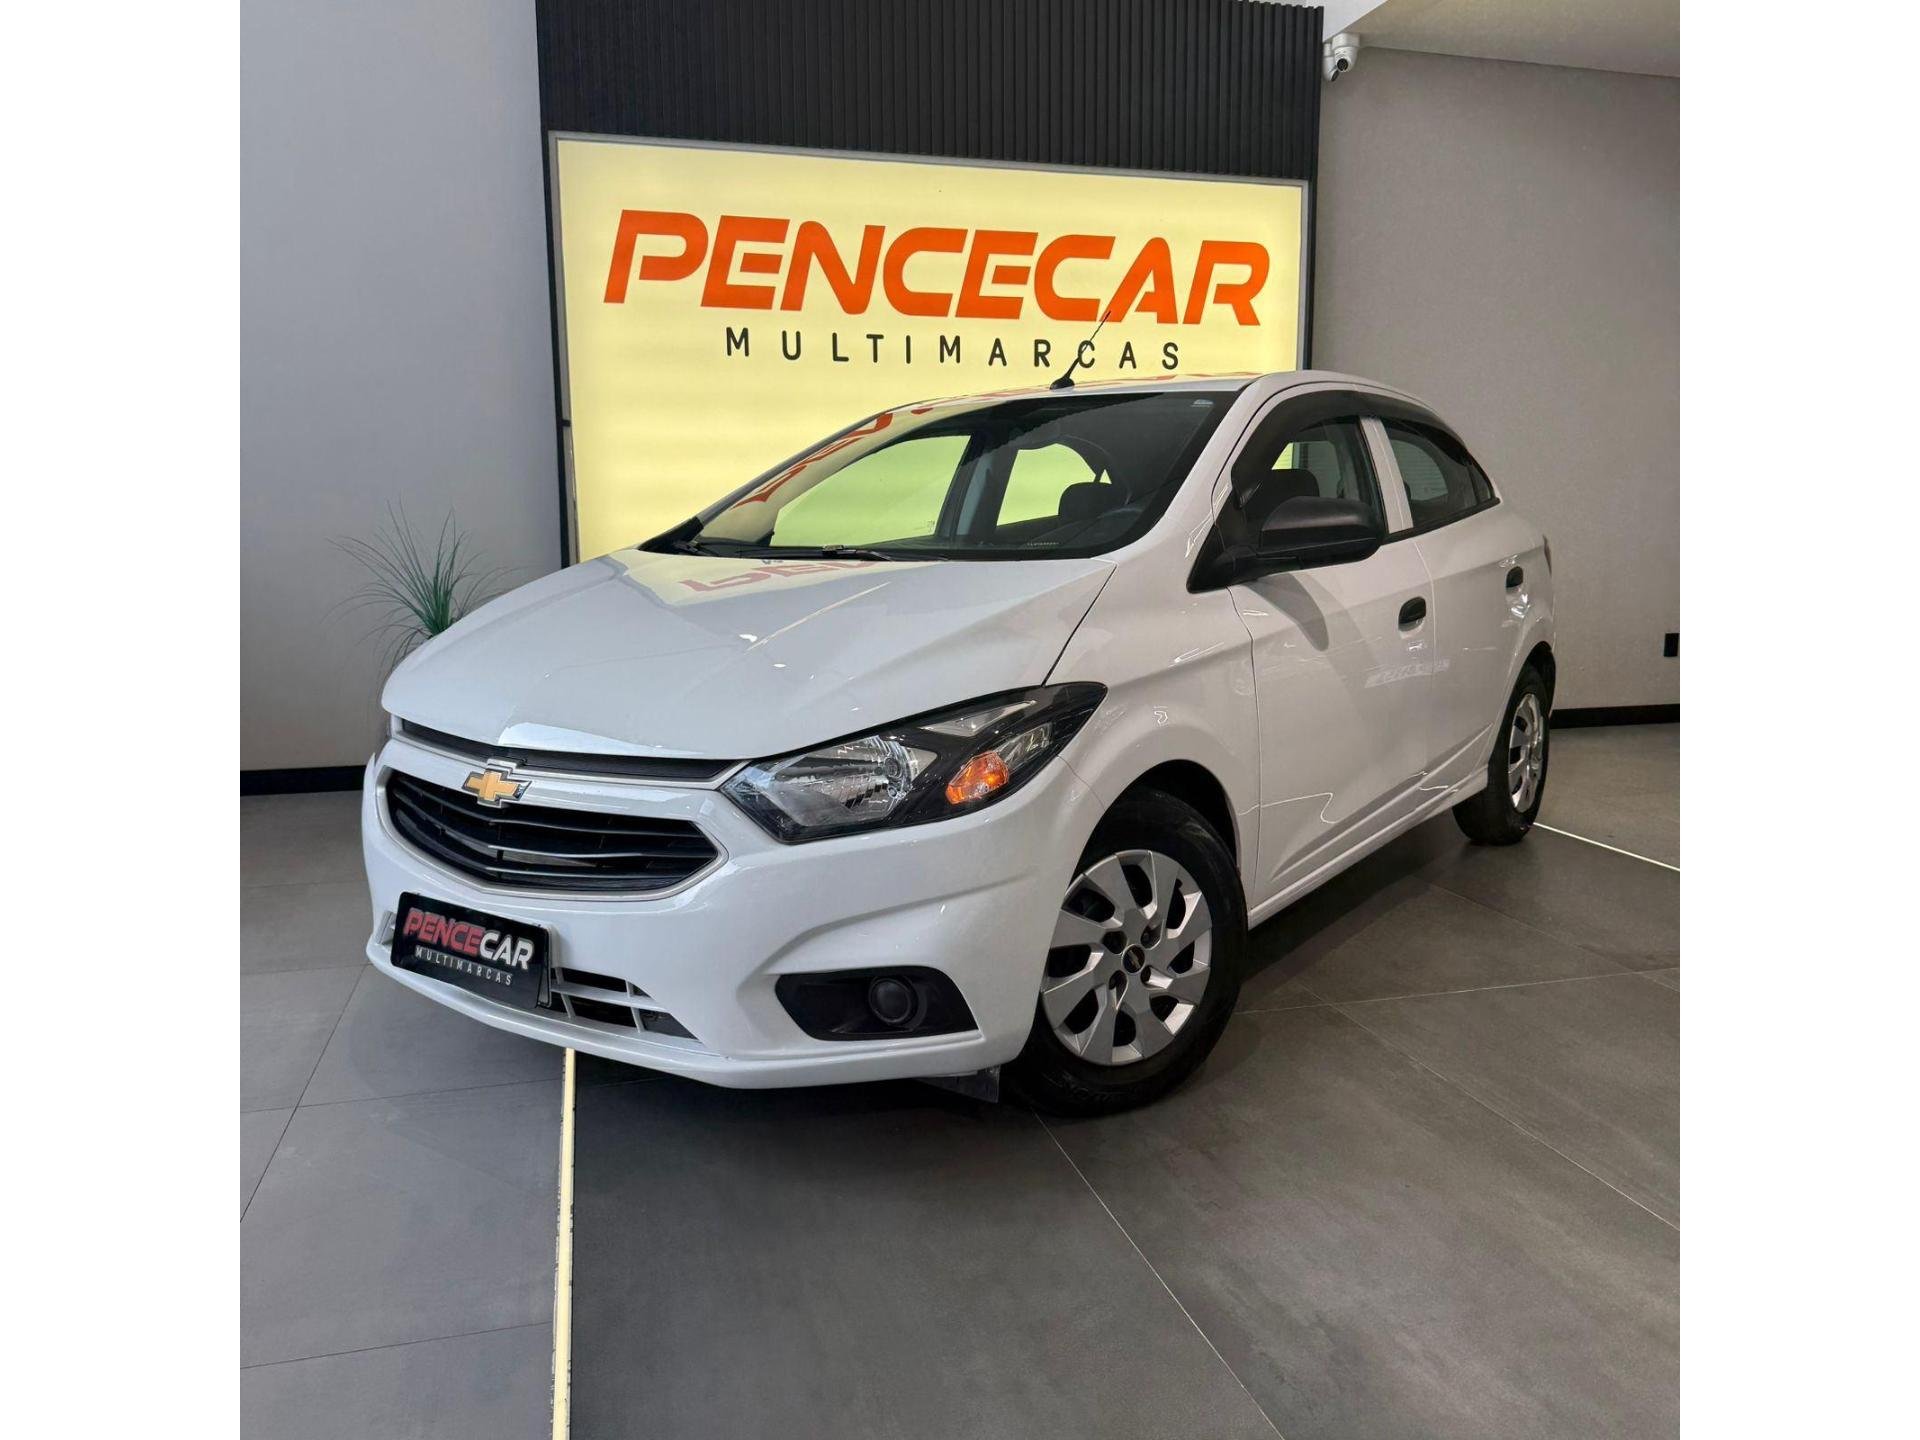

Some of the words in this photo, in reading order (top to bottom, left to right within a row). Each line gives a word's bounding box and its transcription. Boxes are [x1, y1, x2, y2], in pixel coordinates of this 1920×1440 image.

[605, 210, 1269, 326] PENCECAR
[726, 326, 1179, 370] MULTIMARCAS
[404, 908, 534, 970] PENCECAR
[415, 946, 512, 986] MULTIMARCAS
